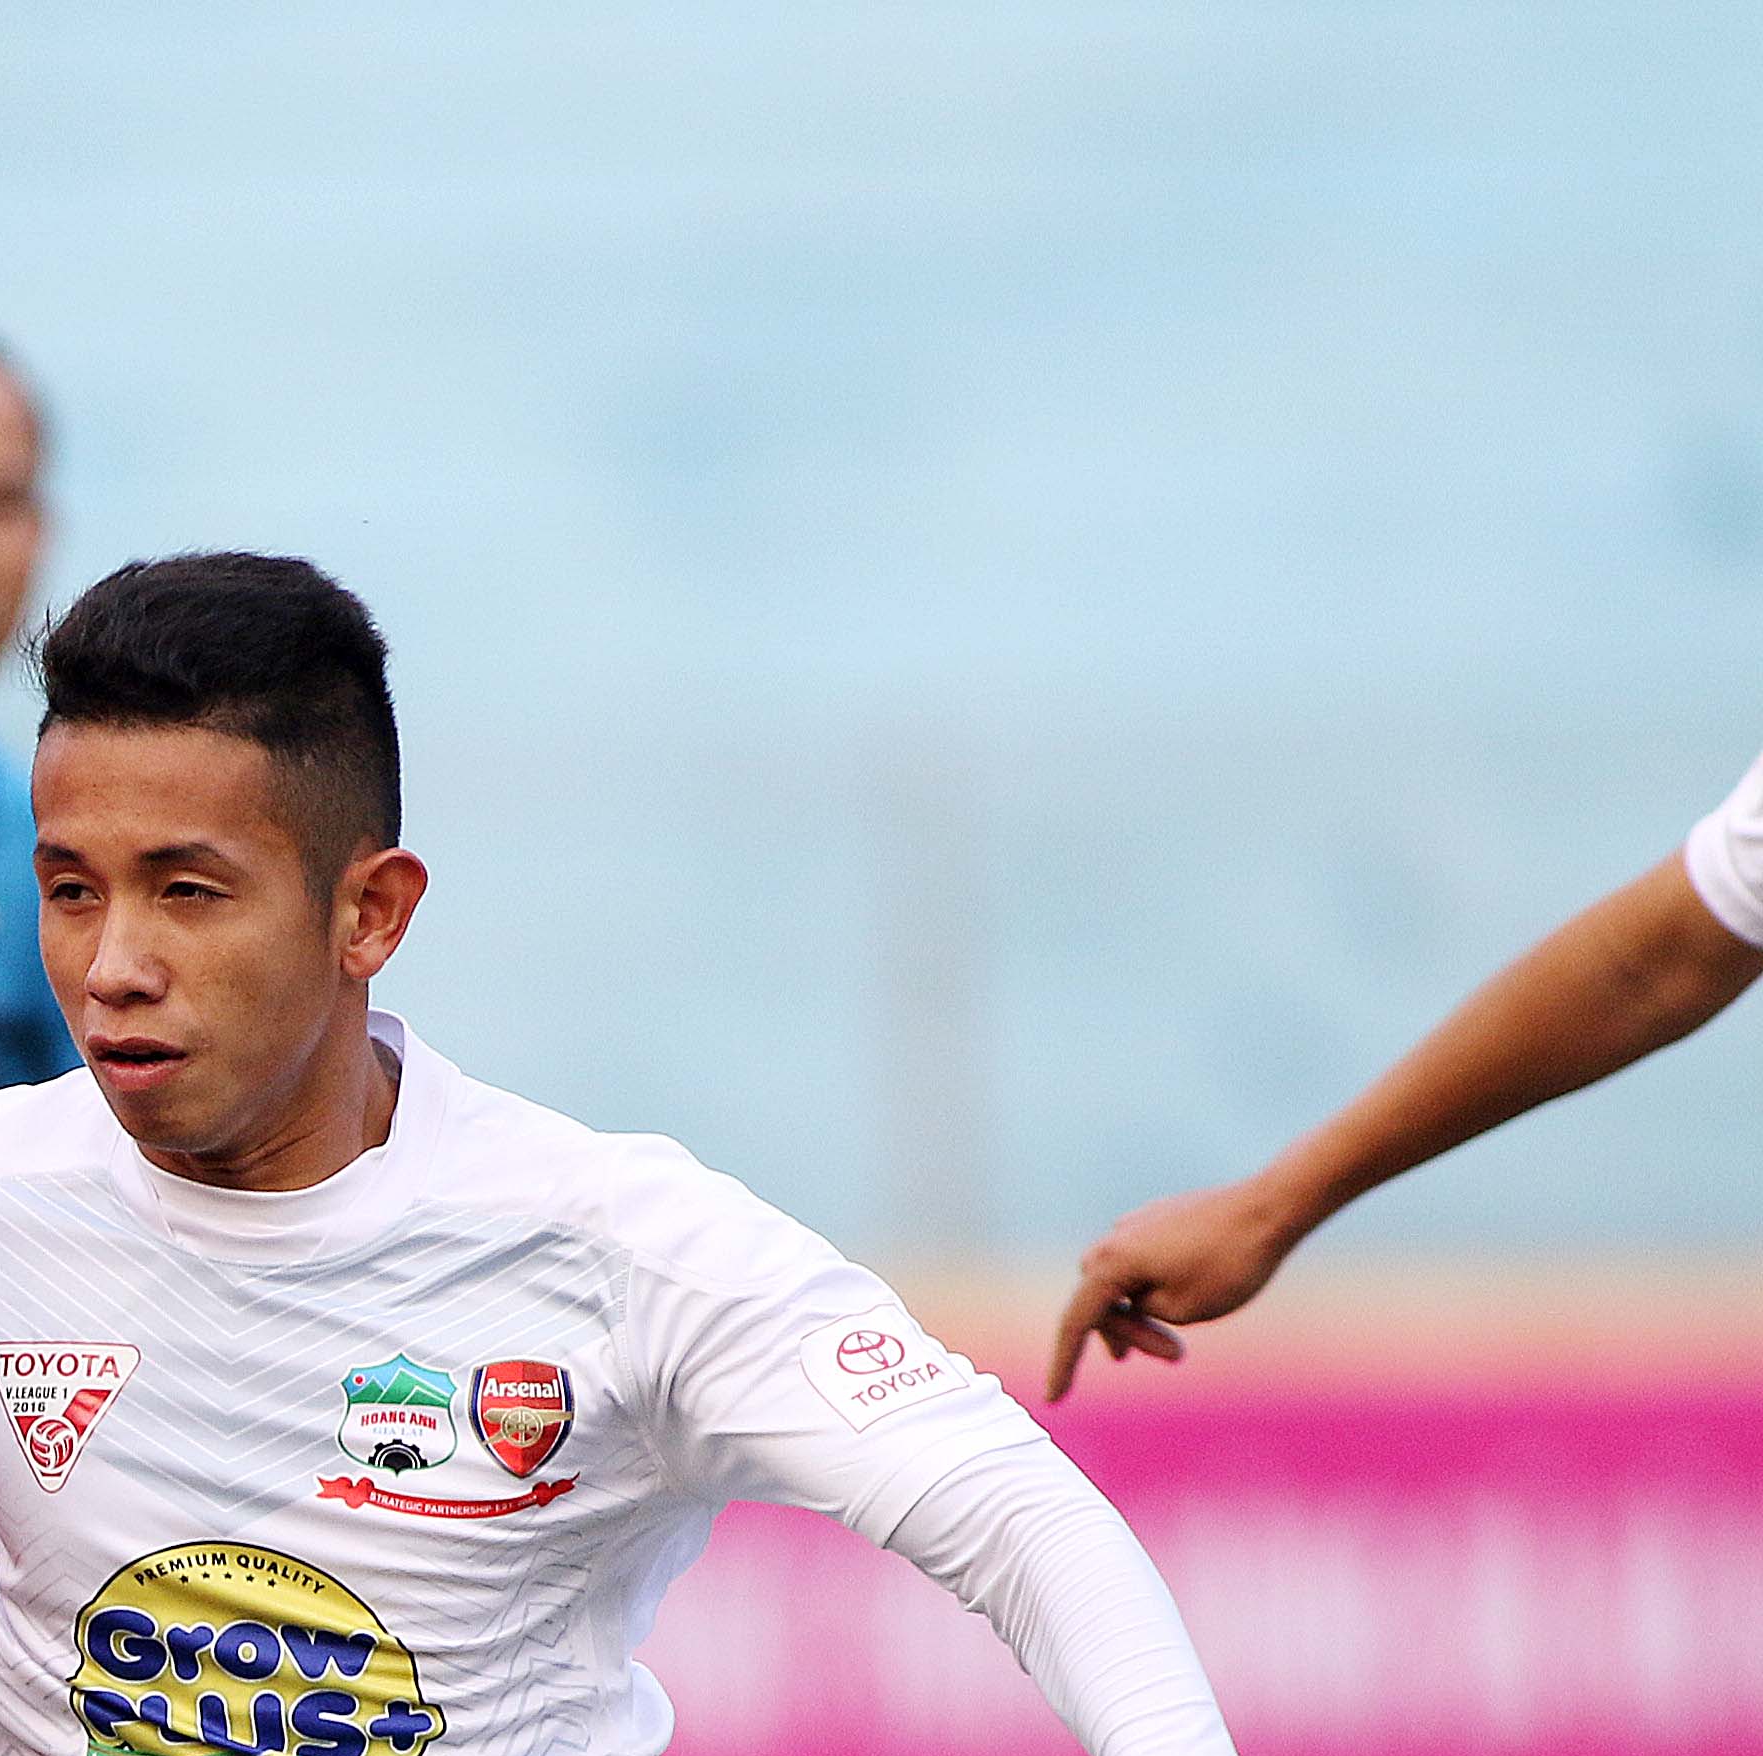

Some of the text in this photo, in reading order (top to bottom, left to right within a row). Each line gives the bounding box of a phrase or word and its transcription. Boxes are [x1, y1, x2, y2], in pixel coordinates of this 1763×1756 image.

[0, 1353, 120, 1378] TOYOTA
[5, 1386, 68, 1400] V.LEAGUE 1
[483, 1378, 560, 1398] Arsenal
[851, 1362, 945, 1407] TOYOTA
[13, 1402, 46, 1413] 2016
[369, 1491, 423, 1512] STRATEGIC
[133, 1552, 325, 1595] PREMIUM QUALITY
[86, 1608, 377, 1682] Grow
